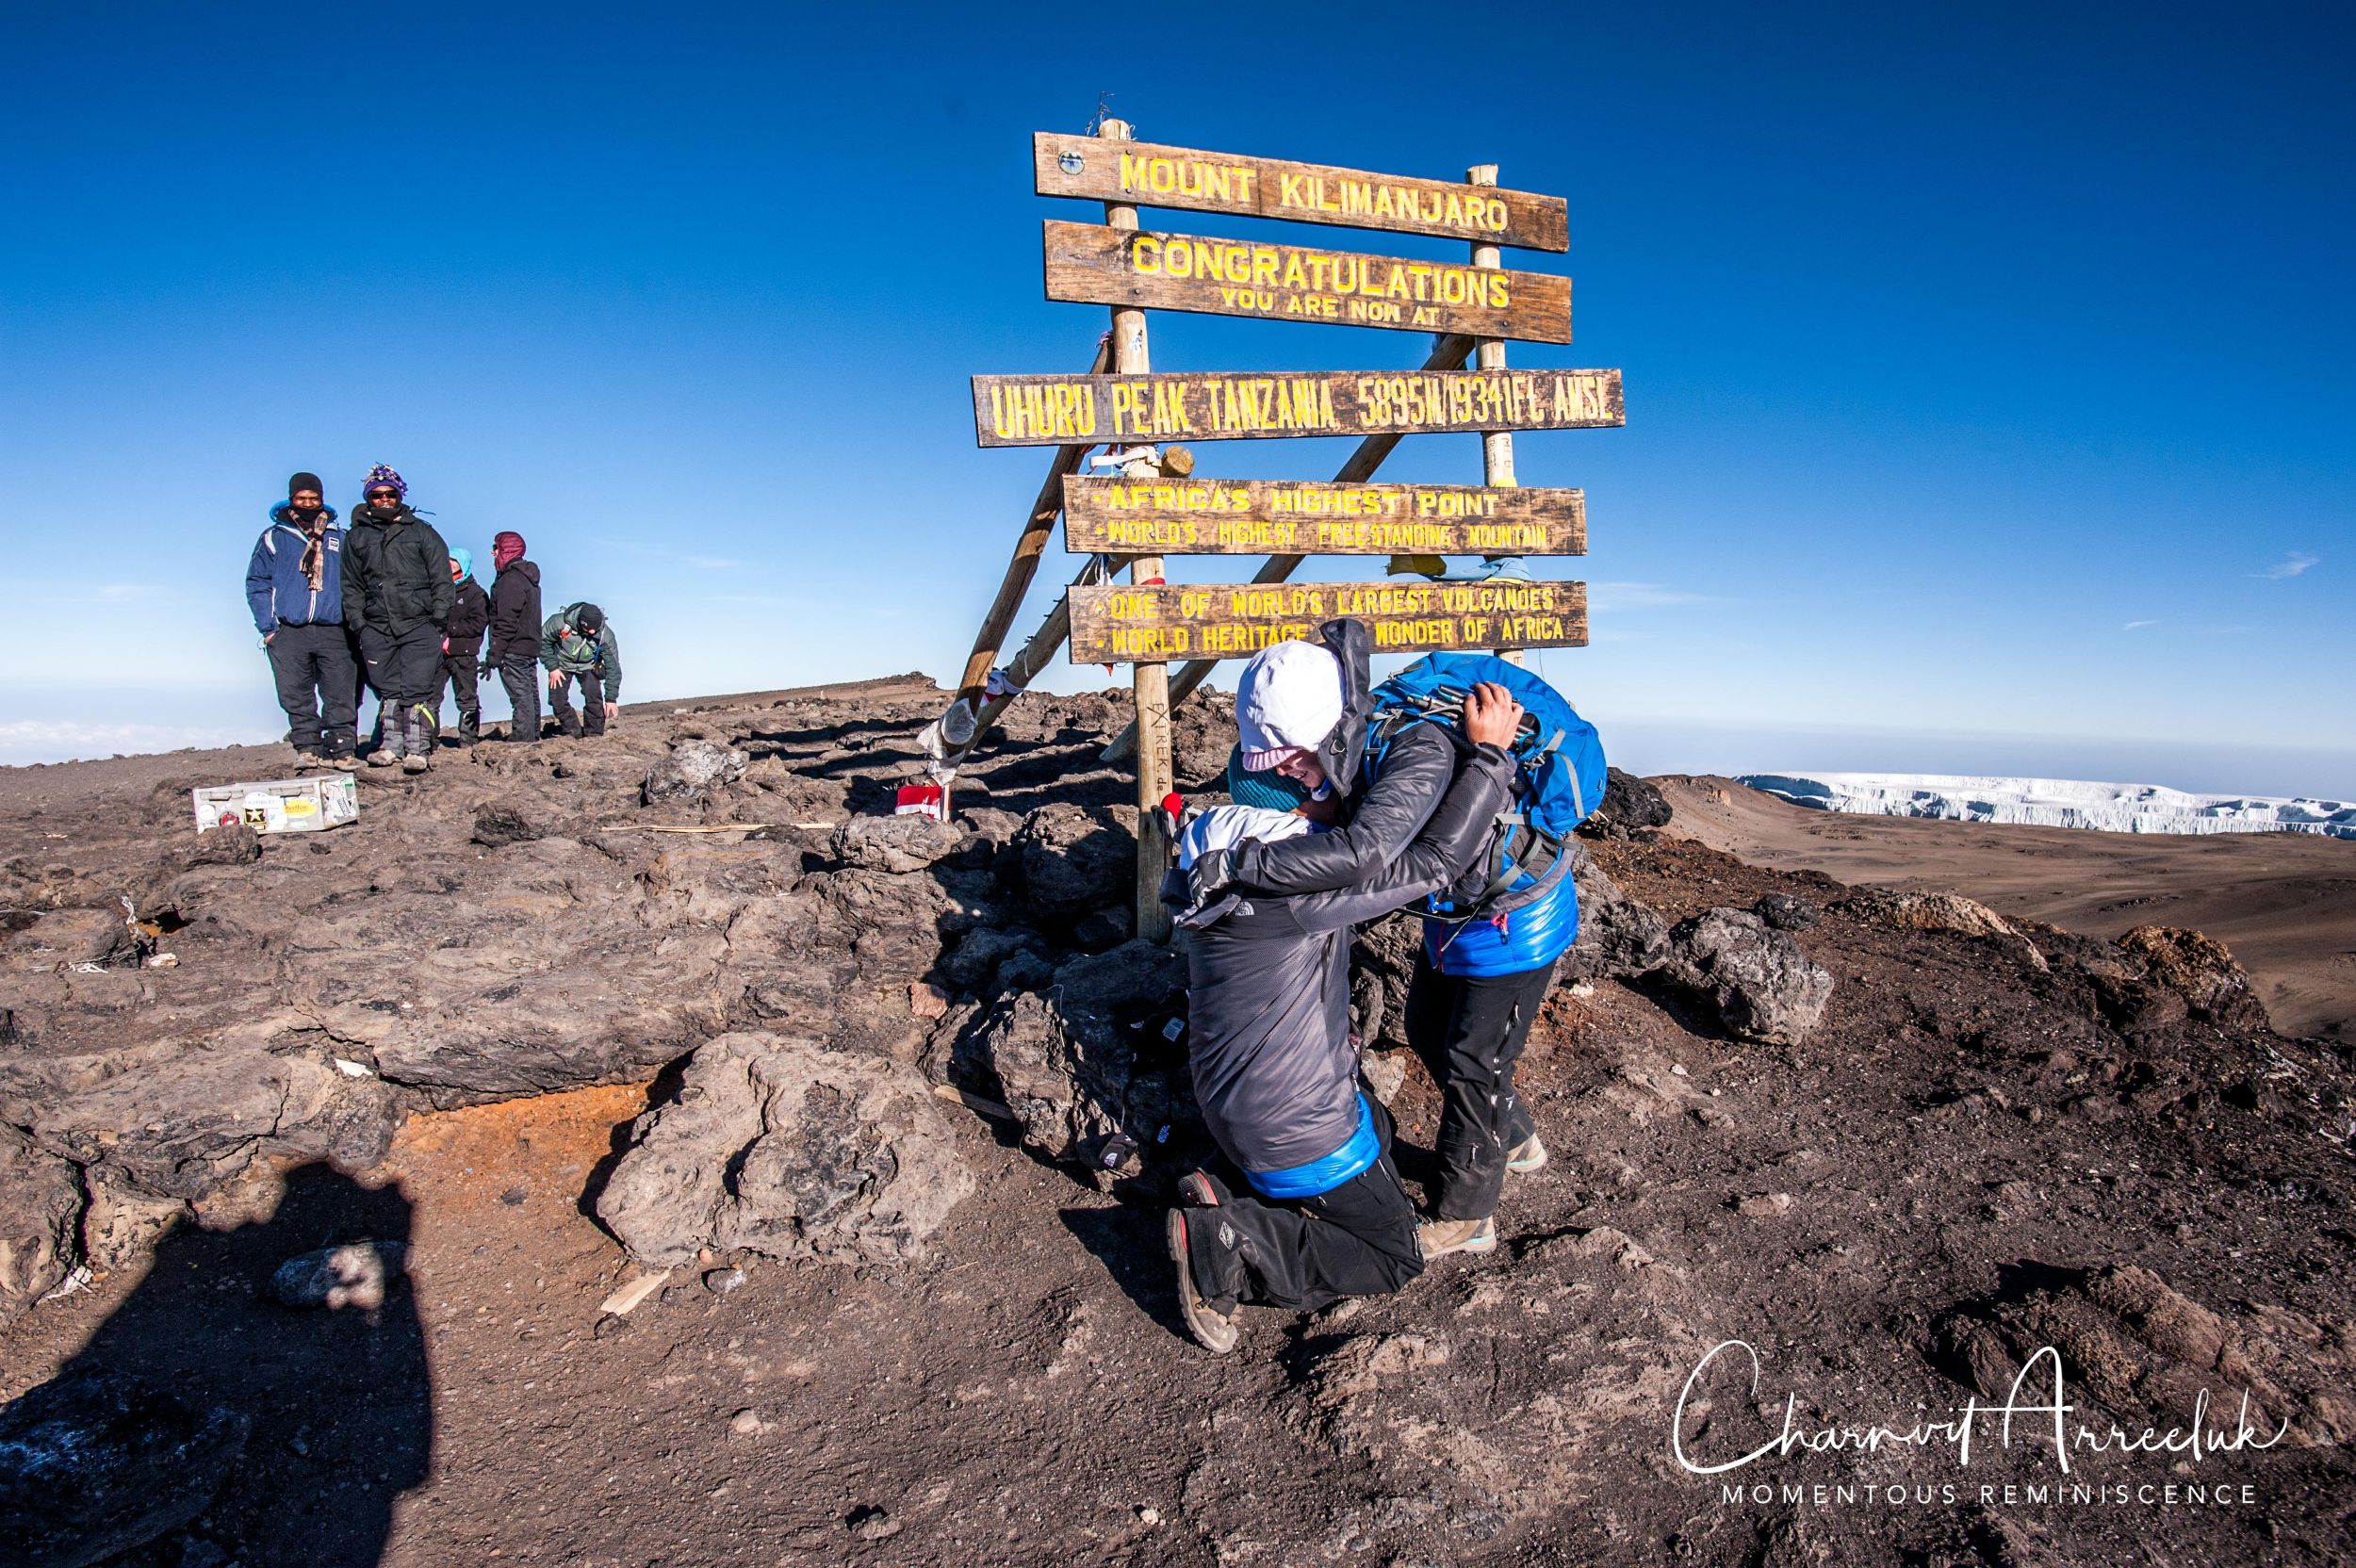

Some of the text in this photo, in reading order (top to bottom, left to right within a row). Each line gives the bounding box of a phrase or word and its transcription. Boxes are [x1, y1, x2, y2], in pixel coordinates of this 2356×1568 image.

[1121, 154, 1509, 233] MOUNT KILIMANJARO
[1132, 236, 1510, 308] CONGRATULATIONS
[1220, 287, 1273, 311] YOU
[1285, 294, 1339, 318] ARE
[1411, 305, 1440, 326] AT
[990, 383, 1096, 439] UHURU
[1110, 381, 1194, 435] PEAK
[1205, 378, 1335, 431] TANZANIA
[1554, 375, 1613, 423] AMSL
[1272, 488, 1402, 514] HIGHEST
[1418, 493, 1499, 516] POINT
[1218, 521, 1299, 545] HIGHEST
[1468, 524, 1547, 547] MOUNTAIN
[1110, 592, 1158, 619] ONE
[1180, 593, 1212, 618] OF
[1336, 588, 1432, 614] LARGEST
[1442, 586, 1555, 611] VOLCANOES
[1112, 626, 1189, 654] WORLD
[1375, 618, 1453, 645] WONDER
[1464, 618, 1489, 642] OF
[1501, 615, 1565, 640] AFRICA
